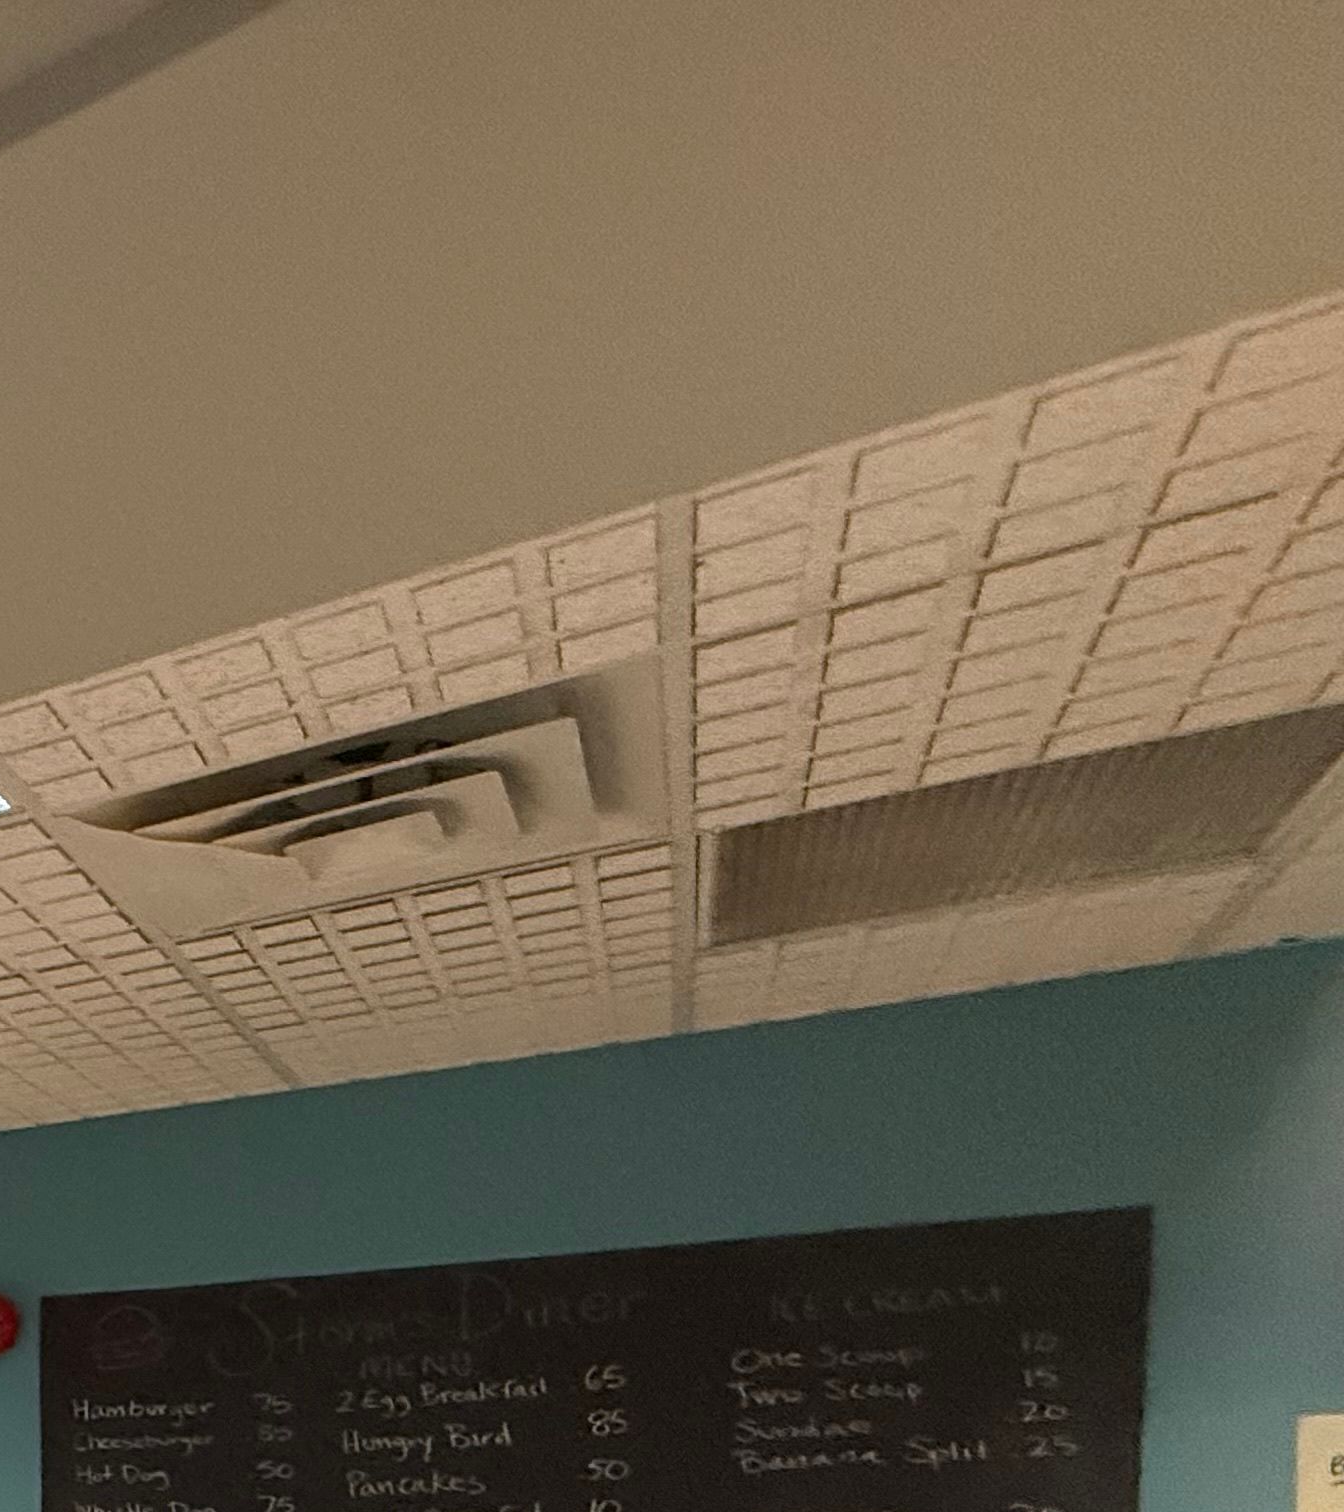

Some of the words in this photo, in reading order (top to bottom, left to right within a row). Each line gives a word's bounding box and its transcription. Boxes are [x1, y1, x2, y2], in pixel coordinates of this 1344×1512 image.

[732, 1347, 805, 1374] One
[72, 1399, 214, 1427] Hamburger
[335, 1390, 354, 1413] 2
[360, 1388, 412, 1419] Egg
[342, 1429, 433, 1462] Hungry
[443, 1421, 512, 1450] Bird
[75, 1463, 112, 1484] Hot
[121, 1463, 170, 1491] Dog
[345, 1469, 487, 1498] Pancakes
